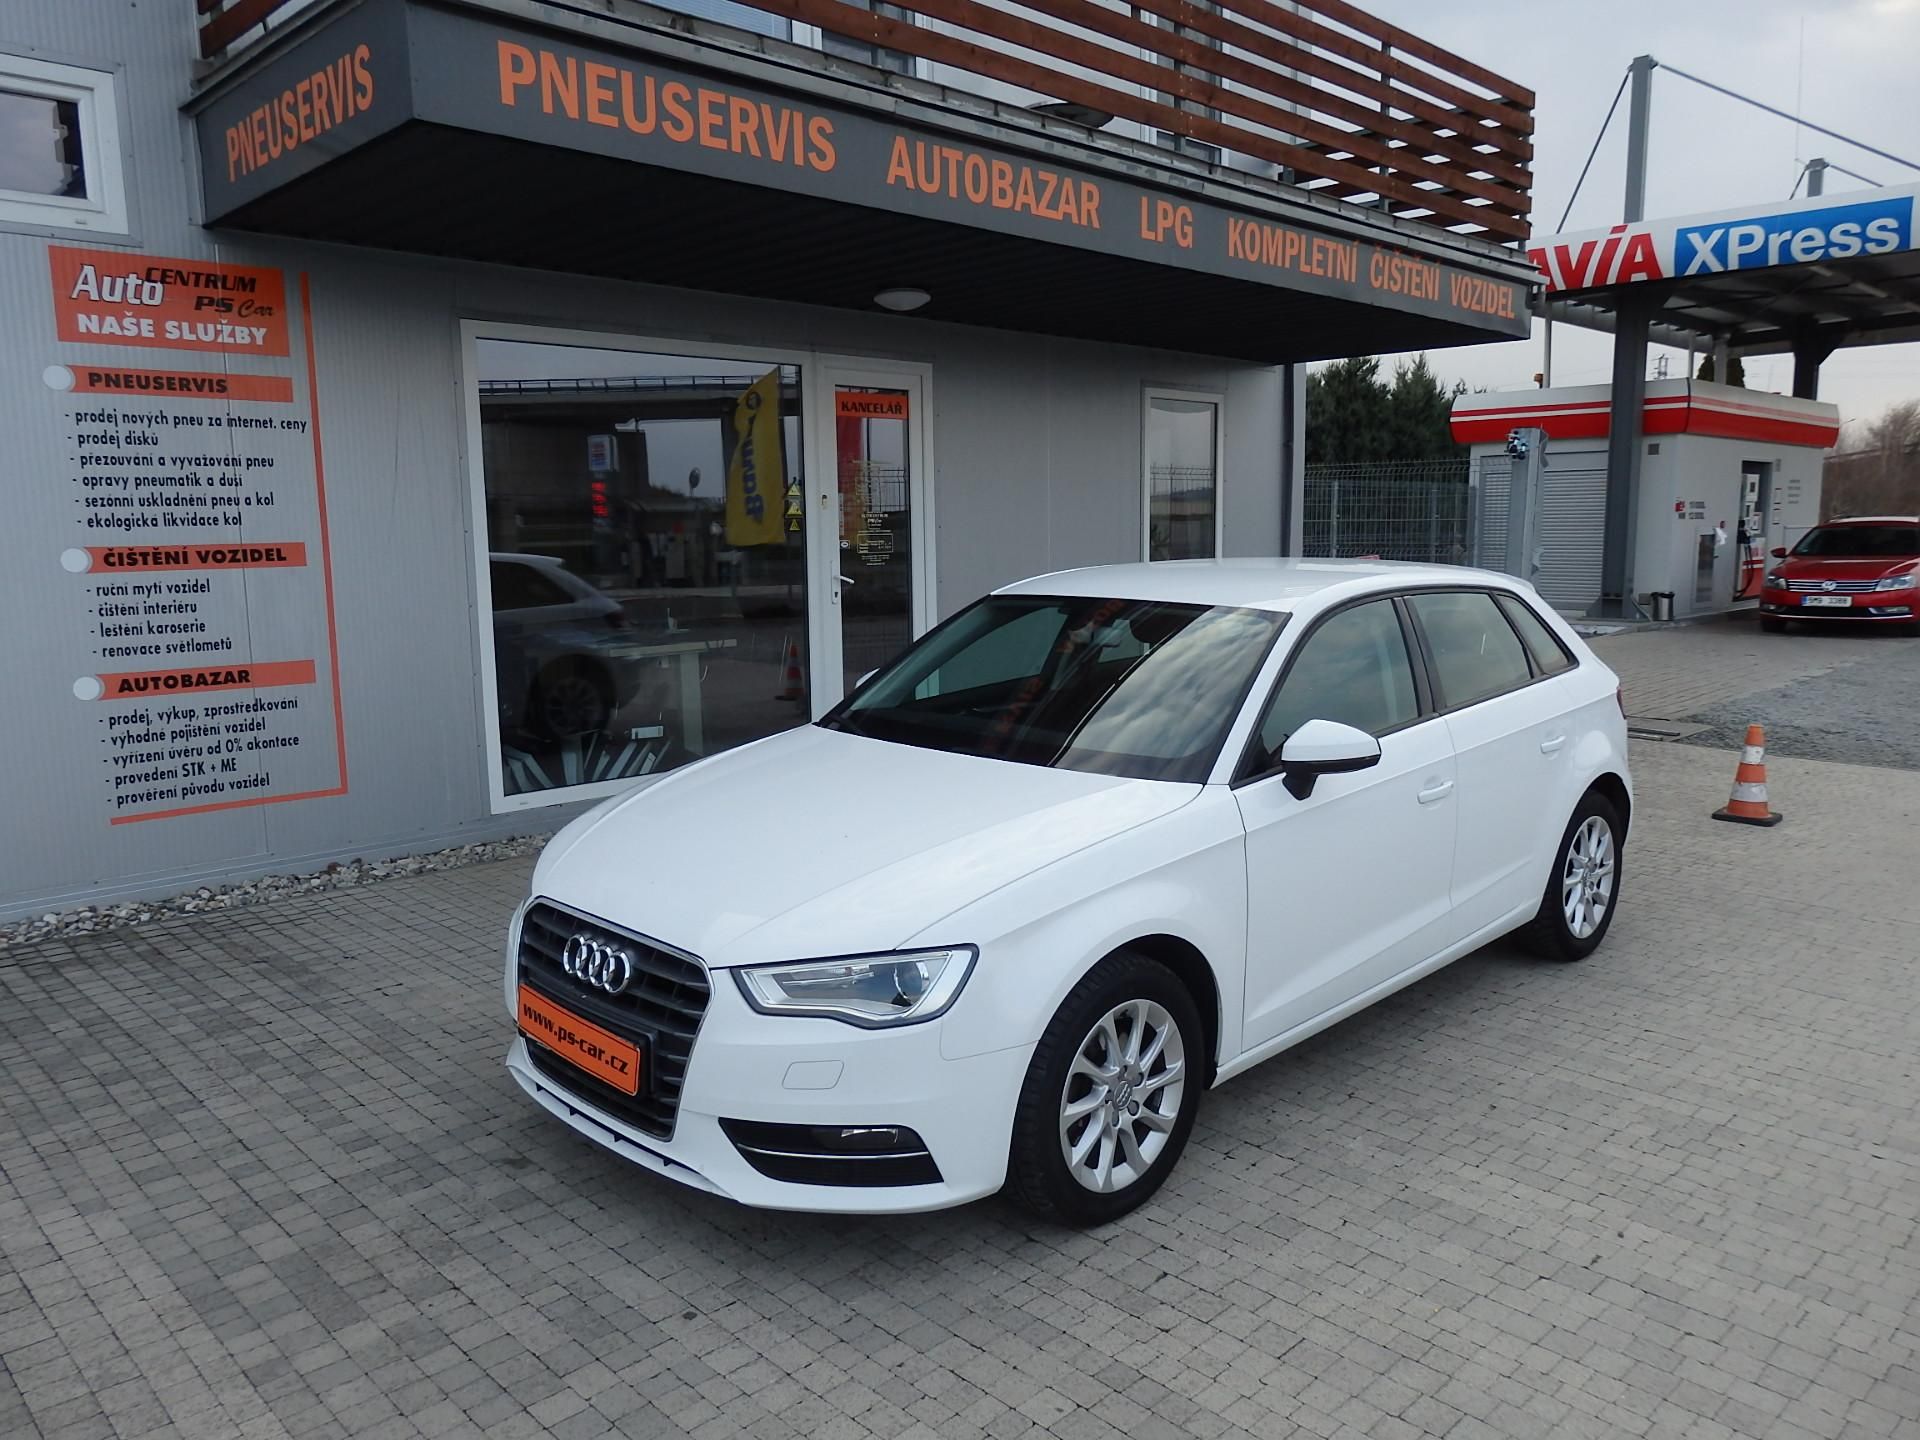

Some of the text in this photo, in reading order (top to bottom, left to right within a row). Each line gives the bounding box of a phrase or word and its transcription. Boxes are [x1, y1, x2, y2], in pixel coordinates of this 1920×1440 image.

[226, 44, 373, 182] PNEUSERVIS
[497, 39, 837, 172] PNEUSERVIS
[887, 136, 1100, 228] AUTOBAZAR
[1140, 196, 1193, 248] LPG
[1227, 216, 1360, 283] KOMPLETNÍ
[1451, 273, 1515, 319] VOZIDEL
[1526, 216, 1901, 292] AVIA XPress
[70, 263, 257, 307] Auto CENTRUM
[194, 295, 275, 318] PS Car
[77, 310, 268, 346] NAŠE SLUŽBY
[88, 372, 228, 394] PNEUSERVIS
[75, 407, 307, 433] prodej nových pneu za internet. ceny
[77, 429, 159, 449] prodej disků
[80, 451, 274, 471] přezouvání a vyvažování pneu
[82, 476, 129, 490] opravy
[134, 472, 202, 490] pneumatik
[207, 476, 214, 487] a
[85, 491, 274, 509] sezónní uskladnění pneu a kol
[87, 511, 242, 531] ekologická likvidace kol
[103, 545, 287, 567] ČIŠTĚNÍ VOZIDEL
[96, 582, 128, 597] ruční
[167, 578, 210, 594] vozidel
[98, 599, 197, 617] čištění interiéru
[100, 618, 206, 637] leštění karoserie
[102, 637, 232, 657] renovace světlometů
[118, 669, 251, 693] AUTOBAZAR
[109, 696, 298, 730] prodej, výkup, zprostředkování
[111, 716, 266, 749] výhodné pojištění vozidel
[113, 736, 300, 769] vyřízení úvěru od 0% akontace
[115, 766, 178, 789] provedení
[182, 761, 205, 778] STK
[221, 757, 237, 773] ME
[117, 772, 270, 809] prověření původu vozidel
[523, 1003, 629, 1075] www.ps-car.cz
